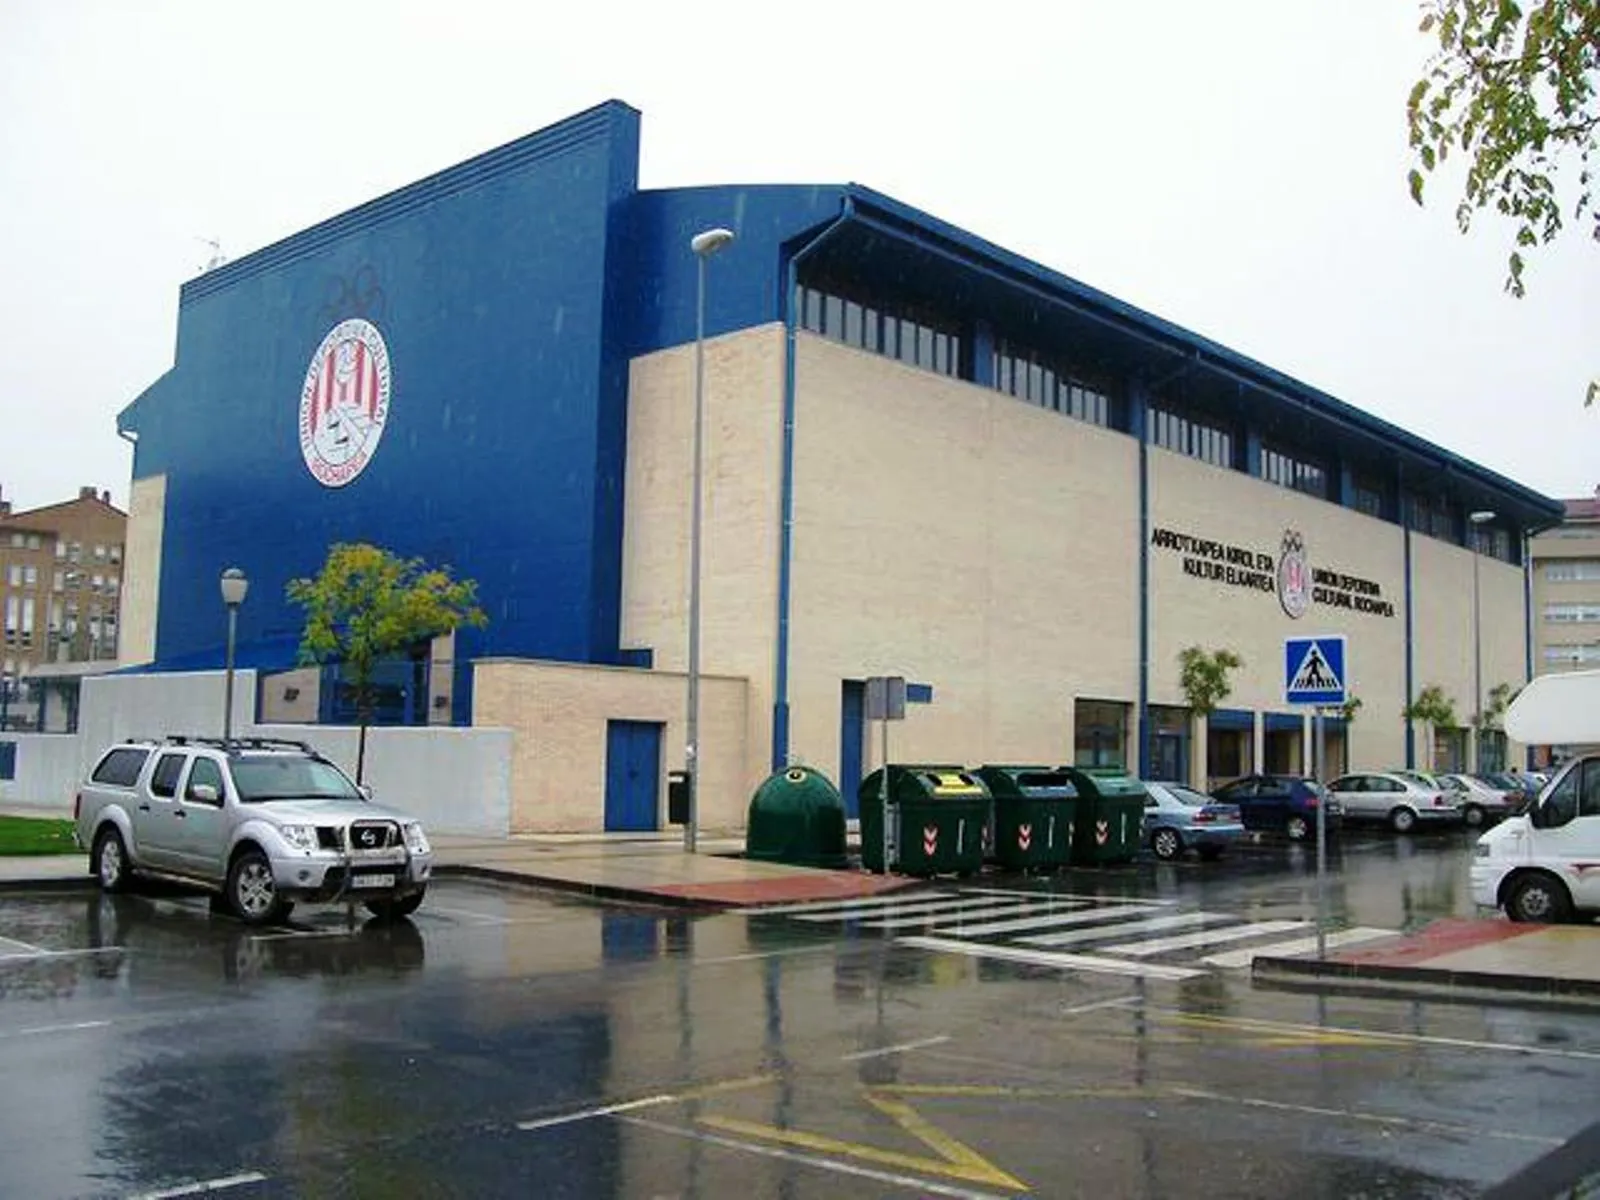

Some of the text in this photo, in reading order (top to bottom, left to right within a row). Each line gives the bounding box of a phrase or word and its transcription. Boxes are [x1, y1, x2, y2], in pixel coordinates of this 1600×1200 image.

[1183, 557, 1275, 593] KULTUR ELKARTEA
[1257, 553, 1275, 573] ETA
